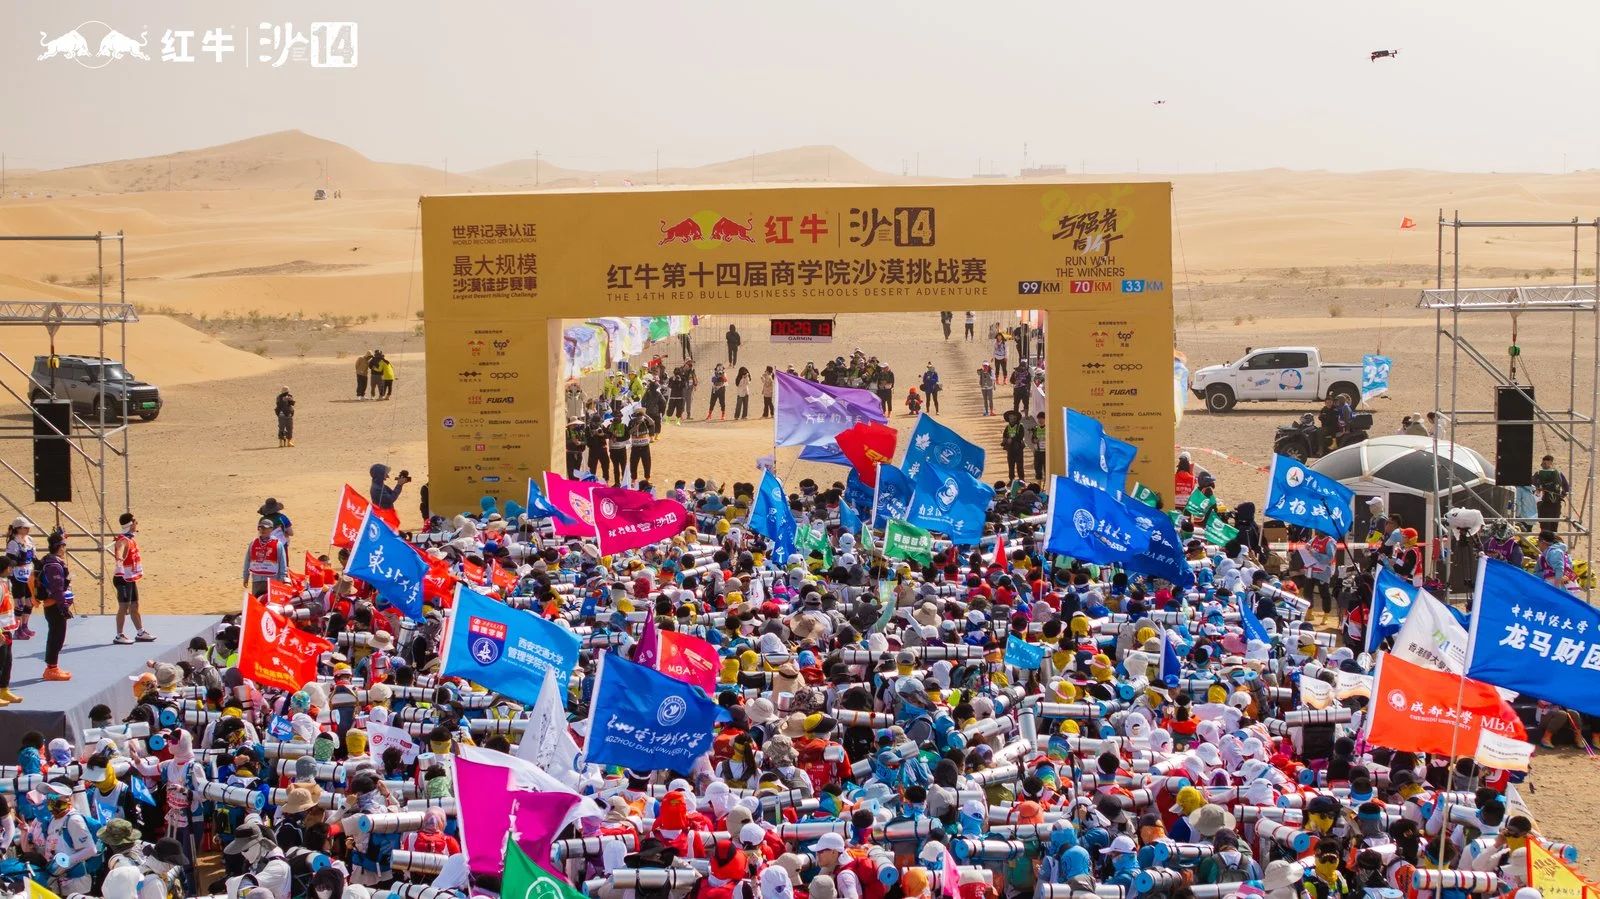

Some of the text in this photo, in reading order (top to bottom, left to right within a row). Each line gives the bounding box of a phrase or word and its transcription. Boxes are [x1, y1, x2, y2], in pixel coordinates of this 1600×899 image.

[452, 223, 537, 239] 世界记录认证
[764, 213, 828, 244] 红牛
[452, 253, 537, 277] 最大规模
[1065, 256, 1087, 267] RUN
[607, 257, 987, 290] 红牛第十四届商学院沙漠挑战赛
[1056, 267, 1125, 278] THE WINNERS
[453, 276, 537, 293] 沙漠徒步赛事
[607, 286, 988, 303] THE 14TH RED BULL BUSINESS SCHOOLS DESERT ADVENTURE
[1511, 603, 1589, 635] 中央财经大学
[518, 636, 564, 666] 西安交通大学
[1410, 700, 1474, 725] 成都大学
[1480, 715, 1516, 733] MBA
